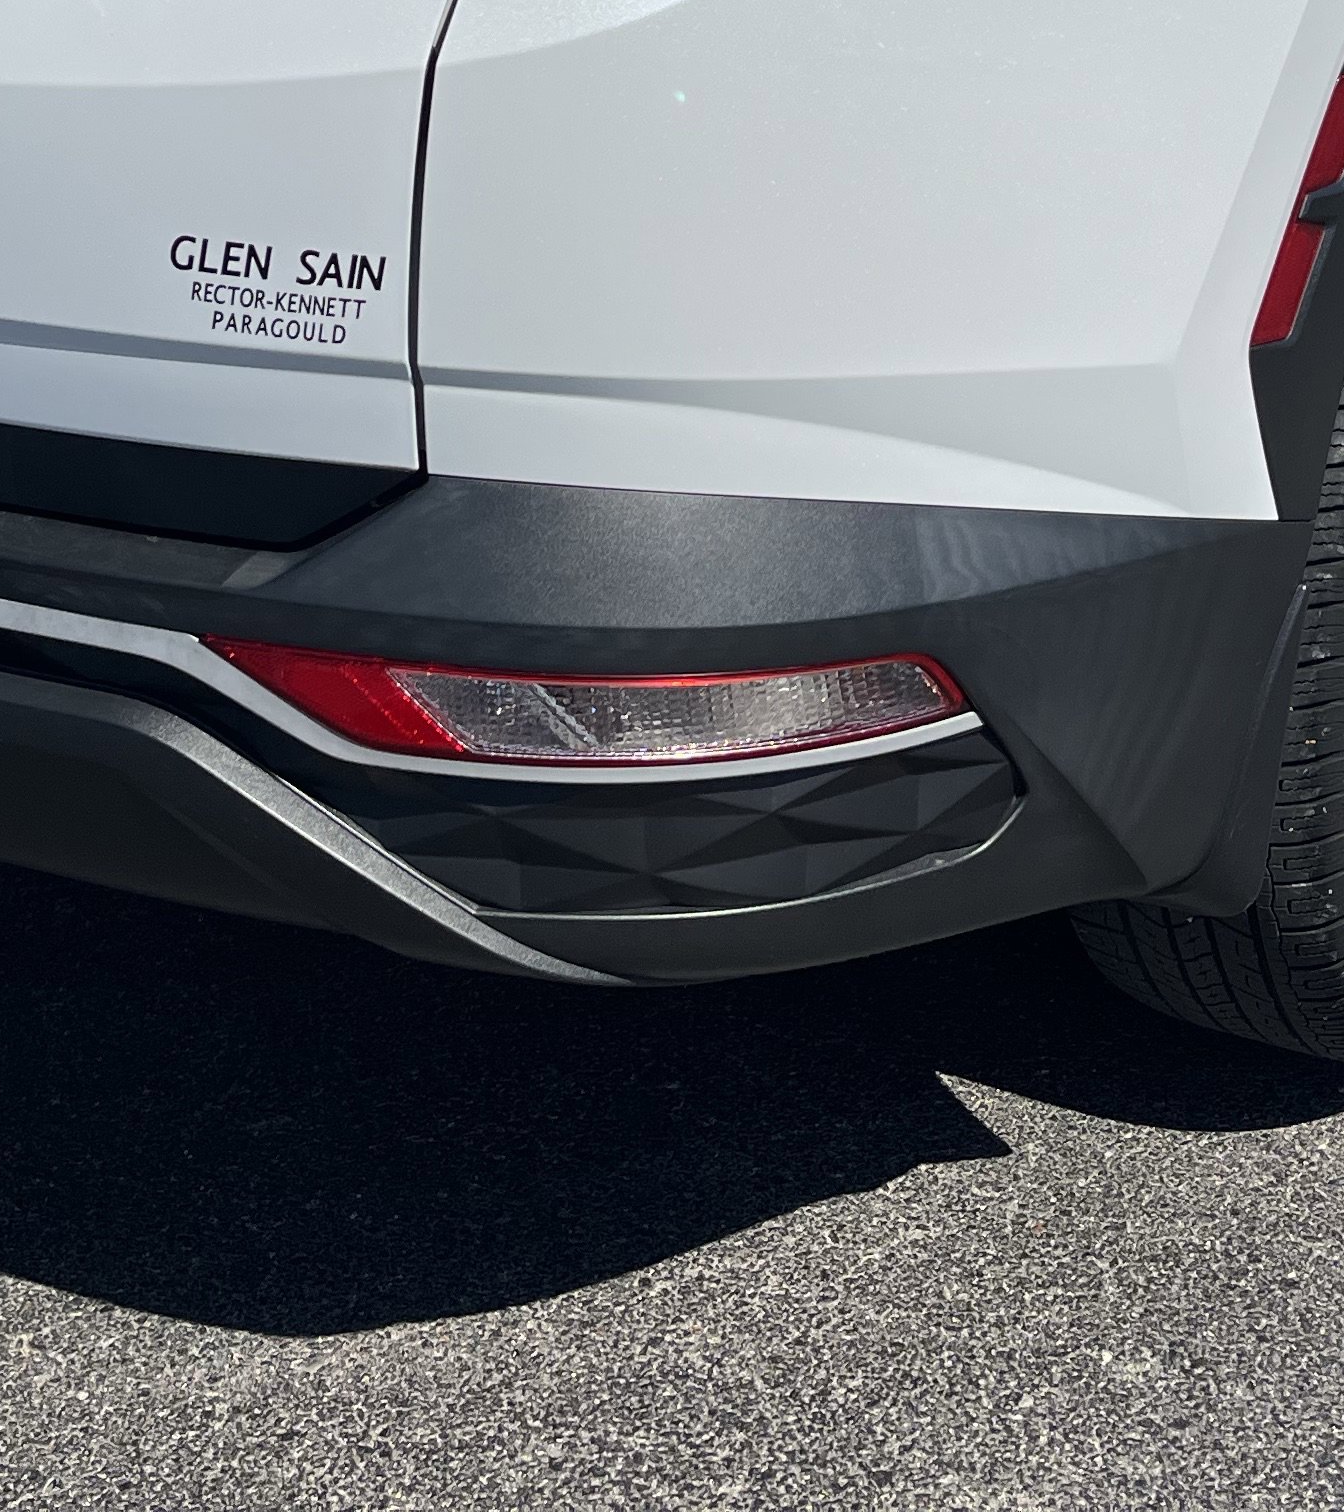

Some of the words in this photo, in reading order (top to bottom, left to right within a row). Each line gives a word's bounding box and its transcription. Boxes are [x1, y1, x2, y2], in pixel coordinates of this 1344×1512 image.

[169, 235, 273, 280] GLEN
[295, 249, 387, 291] SAIN
[191, 281, 367, 320] RECTOR-KENNETT
[211, 310, 347, 345] PARAGOULD
